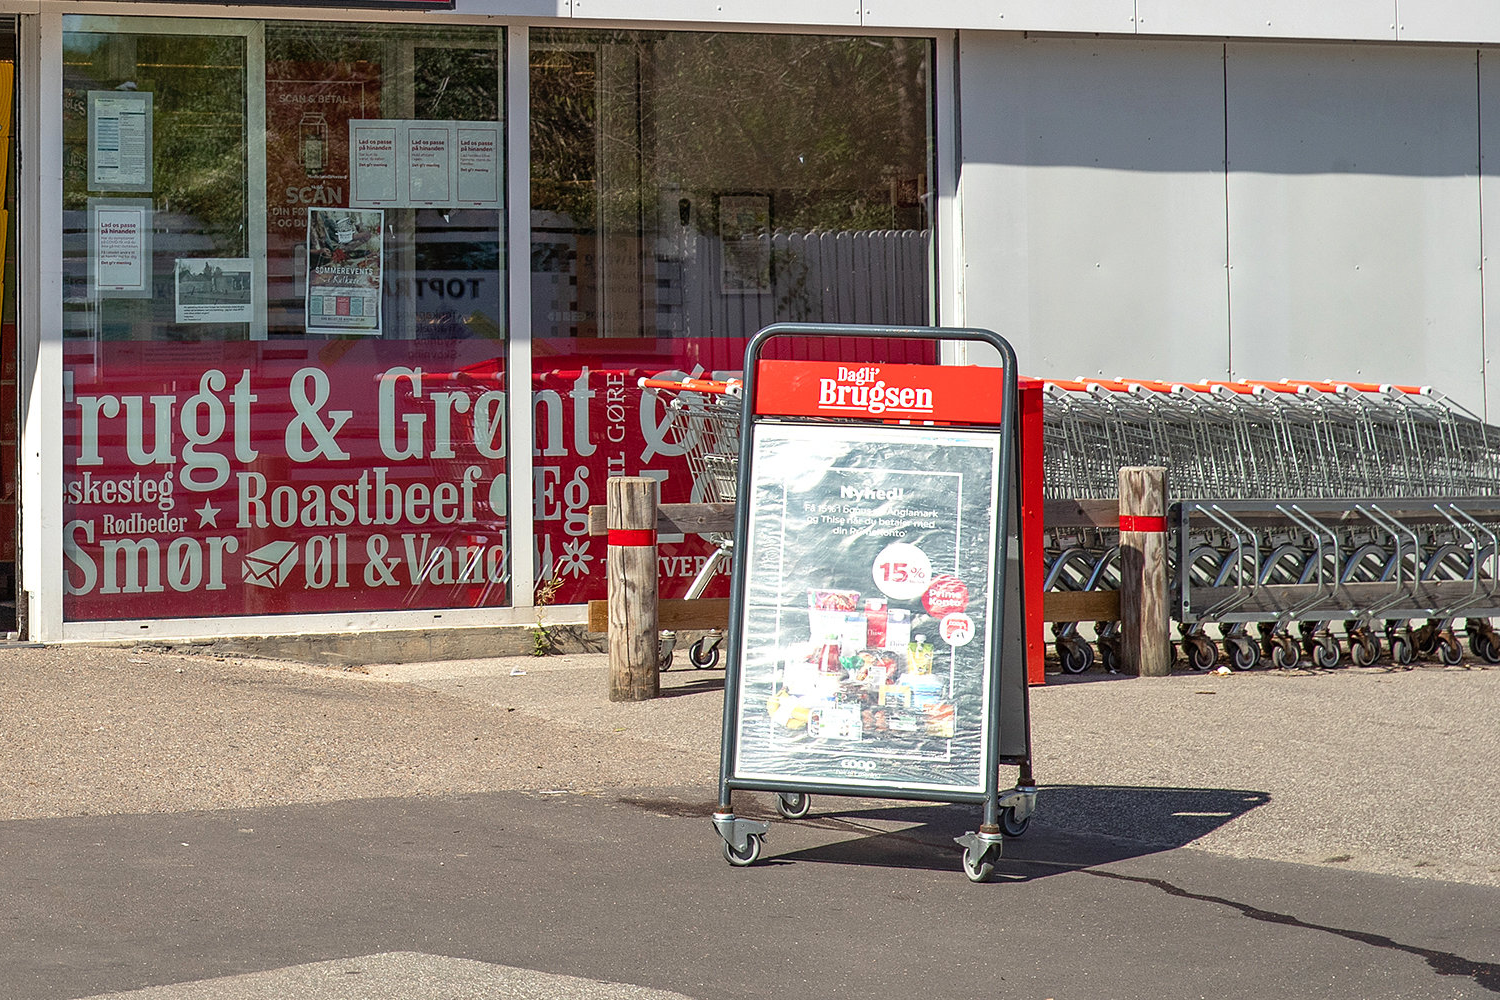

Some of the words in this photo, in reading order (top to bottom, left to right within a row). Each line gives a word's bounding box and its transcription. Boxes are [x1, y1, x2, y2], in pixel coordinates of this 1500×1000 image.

[285, 186, 343, 204] SCAN
[837, 366, 880, 385] Dagli'
[606, 372, 626, 443] GØRE
[818, 378, 934, 413] Brugsen
[284, 366, 353, 463] &
[607, 451, 626, 479] IL
[62, 471, 176, 511] skesteg
[236, 465, 483, 529] Roastbeef
[840, 485, 904, 502] Nyhed!
[102, 512, 189, 536] Rødbeder
[63, 519, 240, 597] Smør
[304, 533, 351, 590] Øl
[363, 533, 402, 588] &
